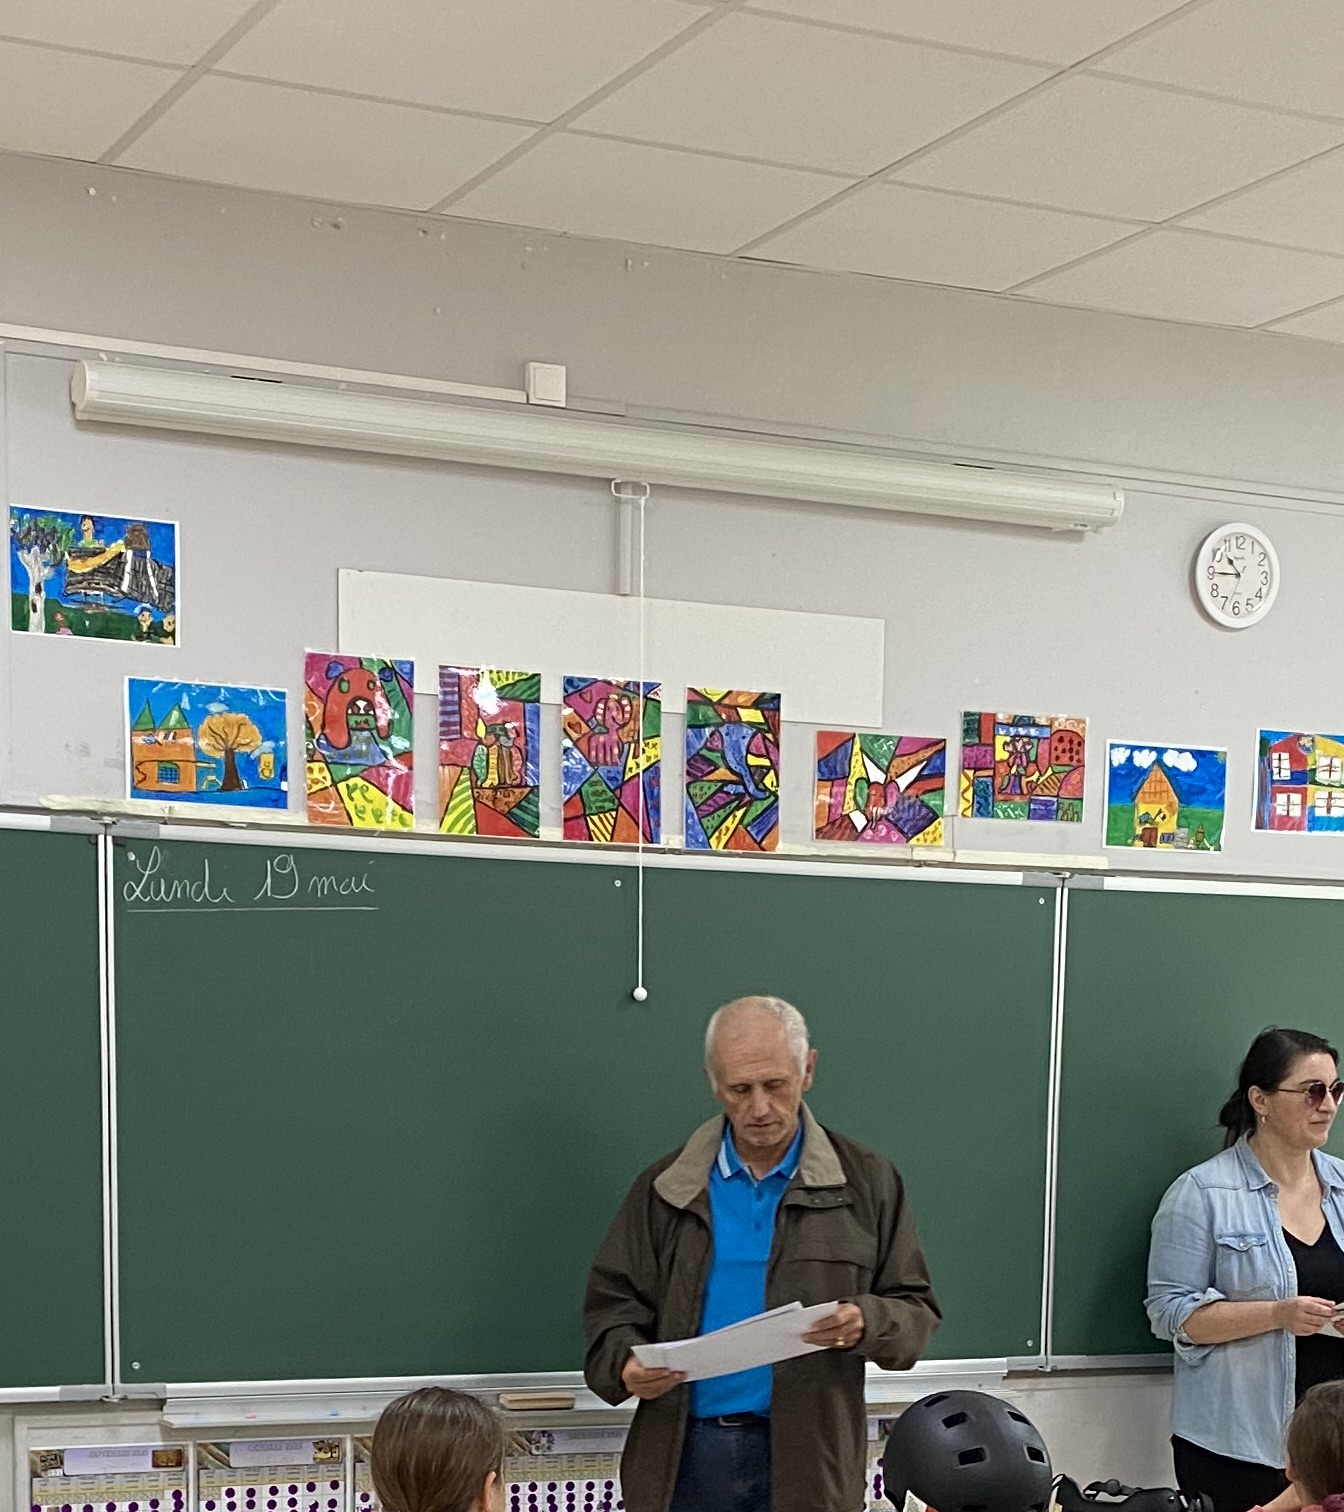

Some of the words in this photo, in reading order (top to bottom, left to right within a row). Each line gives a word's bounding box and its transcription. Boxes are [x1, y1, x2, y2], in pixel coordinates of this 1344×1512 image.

[1223, 539, 1231, 553] 11
[1235, 535, 1245, 550] 12
[1251, 541, 1254, 554] 1
[1212, 547, 1223, 563] 10
[1258, 552, 1266, 566] 2
[1207, 565, 1215, 580] 9
[1260, 570, 1268, 585] 3
[1210, 583, 1219, 598] 8
[1254, 587, 1263, 601] 4
[1220, 595, 1228, 610] 7
[1232, 600, 1240, 616] 6
[1245, 598, 1254, 613] 5
[123, 845, 235, 903] Lundi
[253, 853, 299, 900] 19
[308, 859, 375, 898] mai
